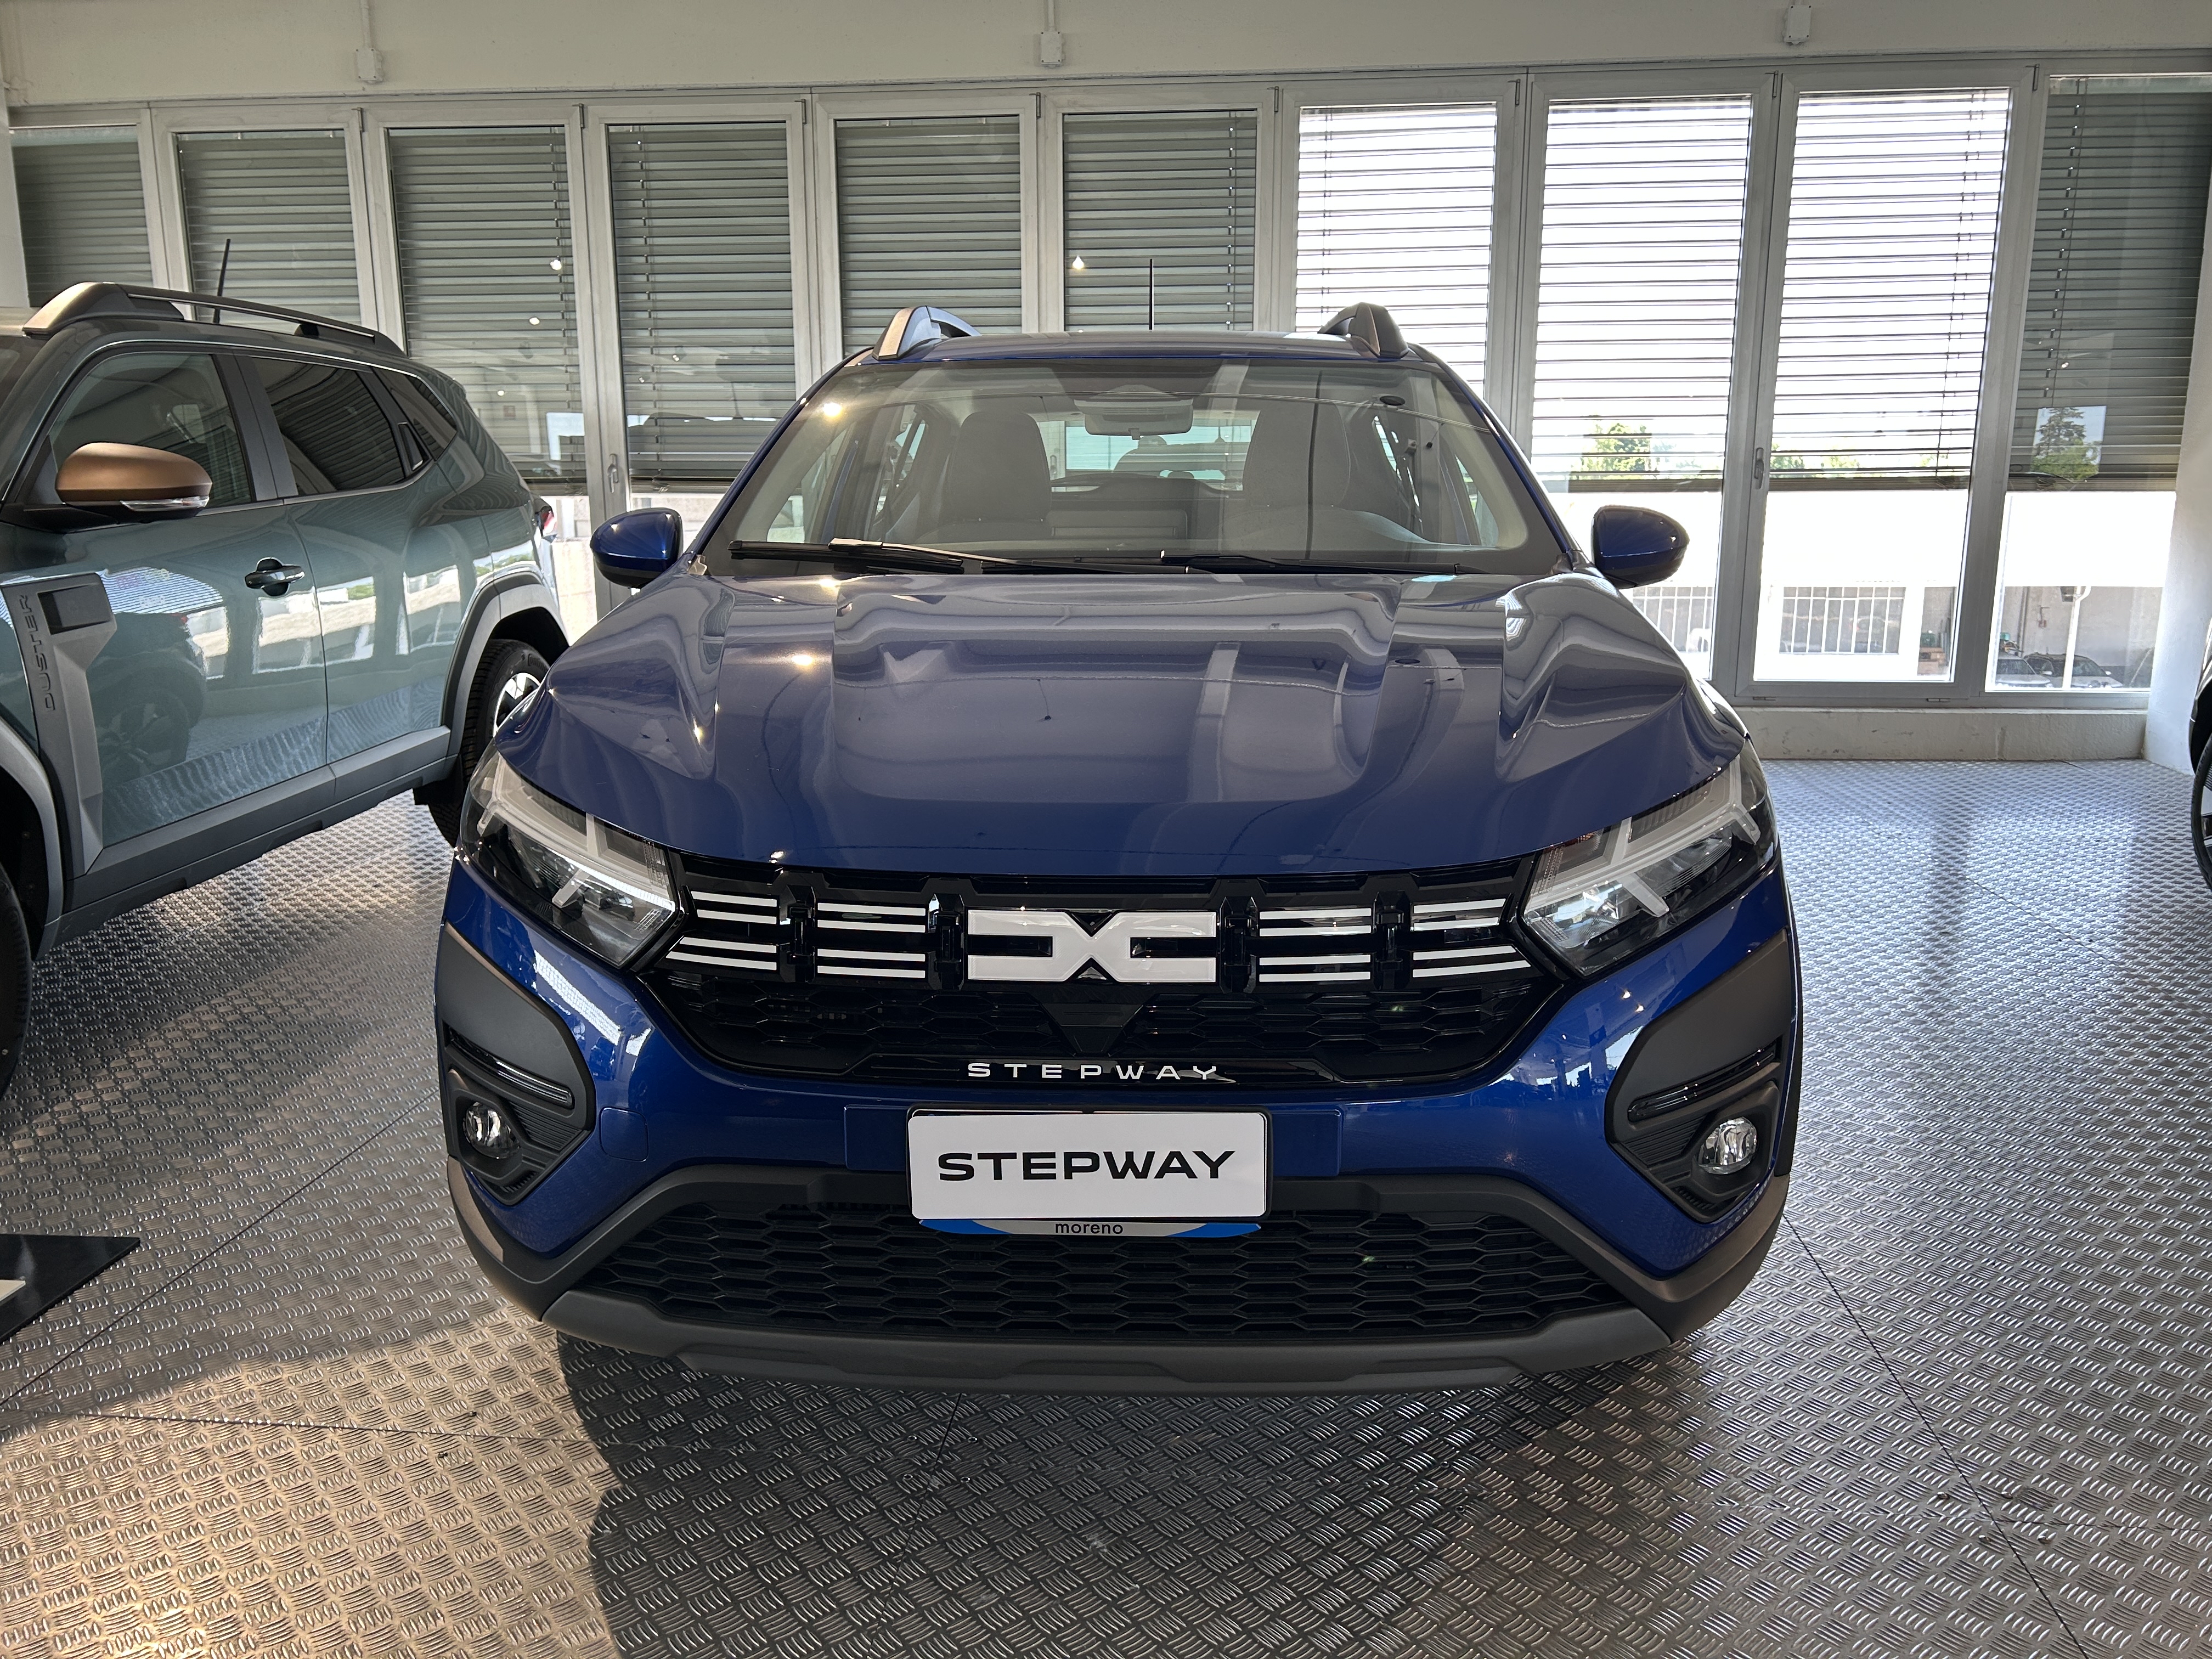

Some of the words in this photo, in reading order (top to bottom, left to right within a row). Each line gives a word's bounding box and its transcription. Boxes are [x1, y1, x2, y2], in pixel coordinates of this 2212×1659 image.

[19, 595, 55, 711] DUSTER
[968, 1063, 1216, 1080] STEPWAY
[938, 1150, 1236, 1182] STEPWAY
[1055, 1223, 1124, 1235] moreno
